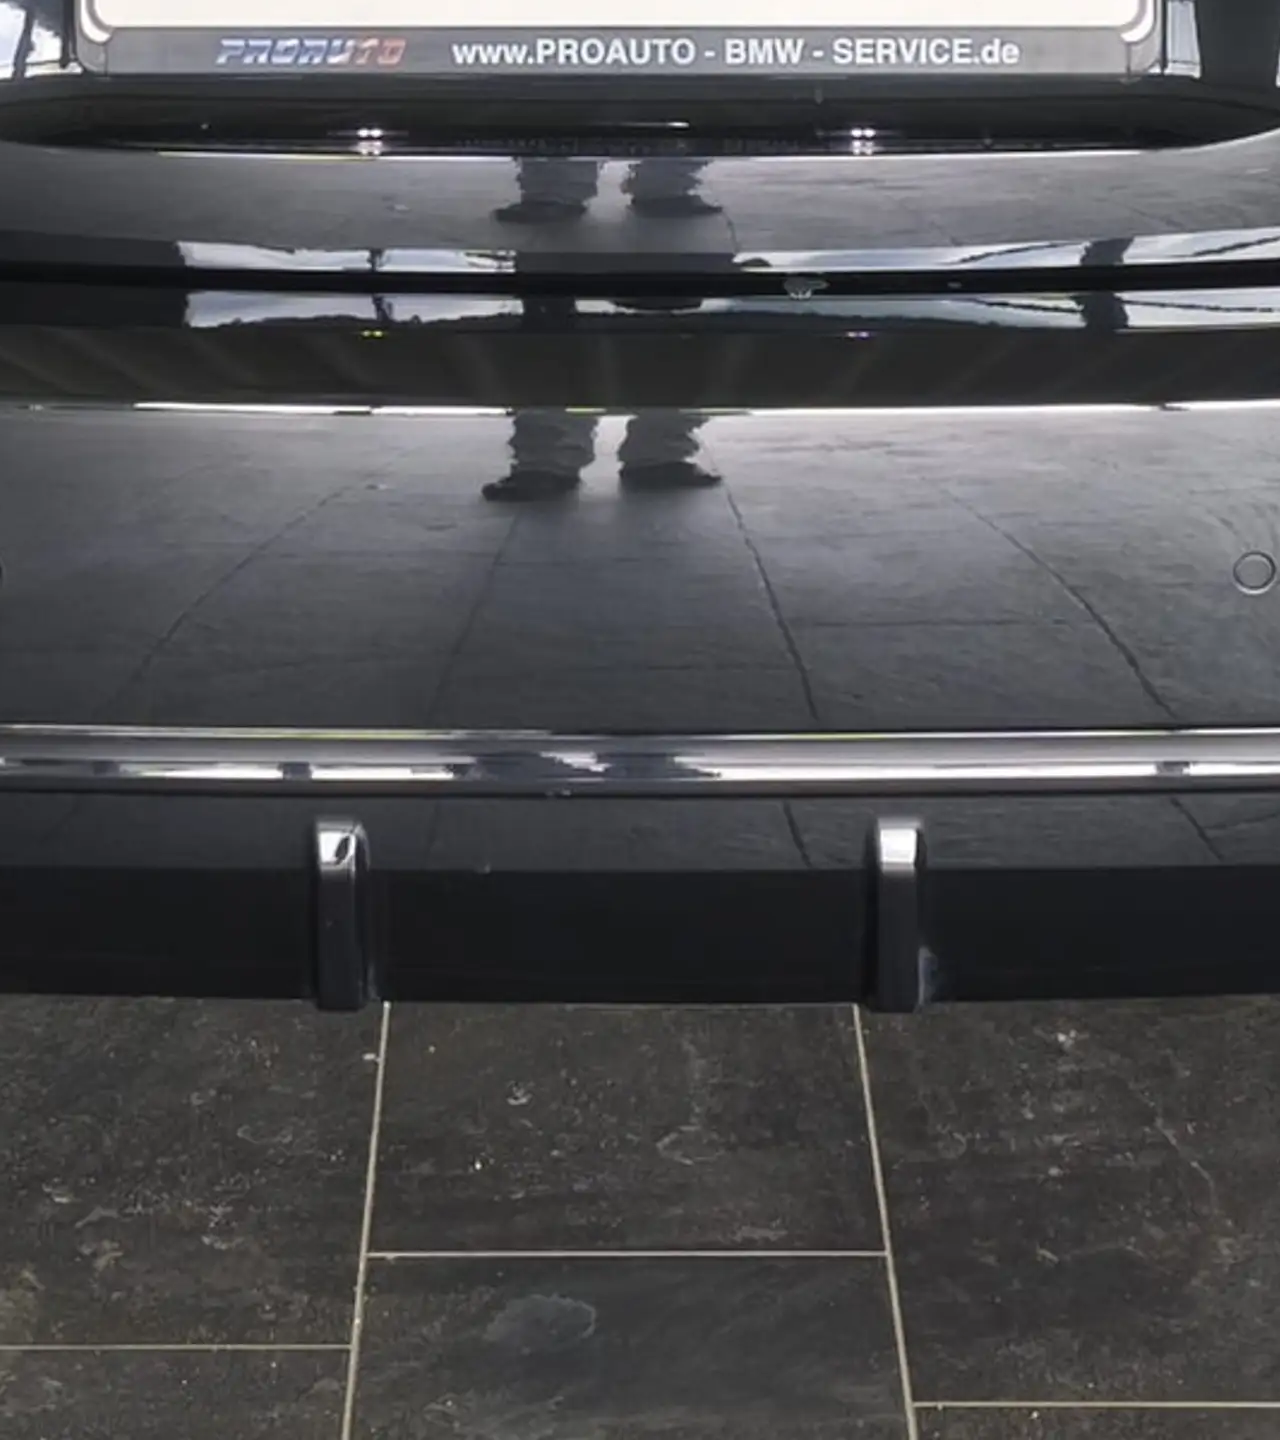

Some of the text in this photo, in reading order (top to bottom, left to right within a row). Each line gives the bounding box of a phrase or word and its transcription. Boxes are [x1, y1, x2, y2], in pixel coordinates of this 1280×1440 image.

[452, 38, 696, 65] www.PROAUTO
[725, 38, 805, 65] BMW
[832, 37, 1020, 65] SERVICE.de
